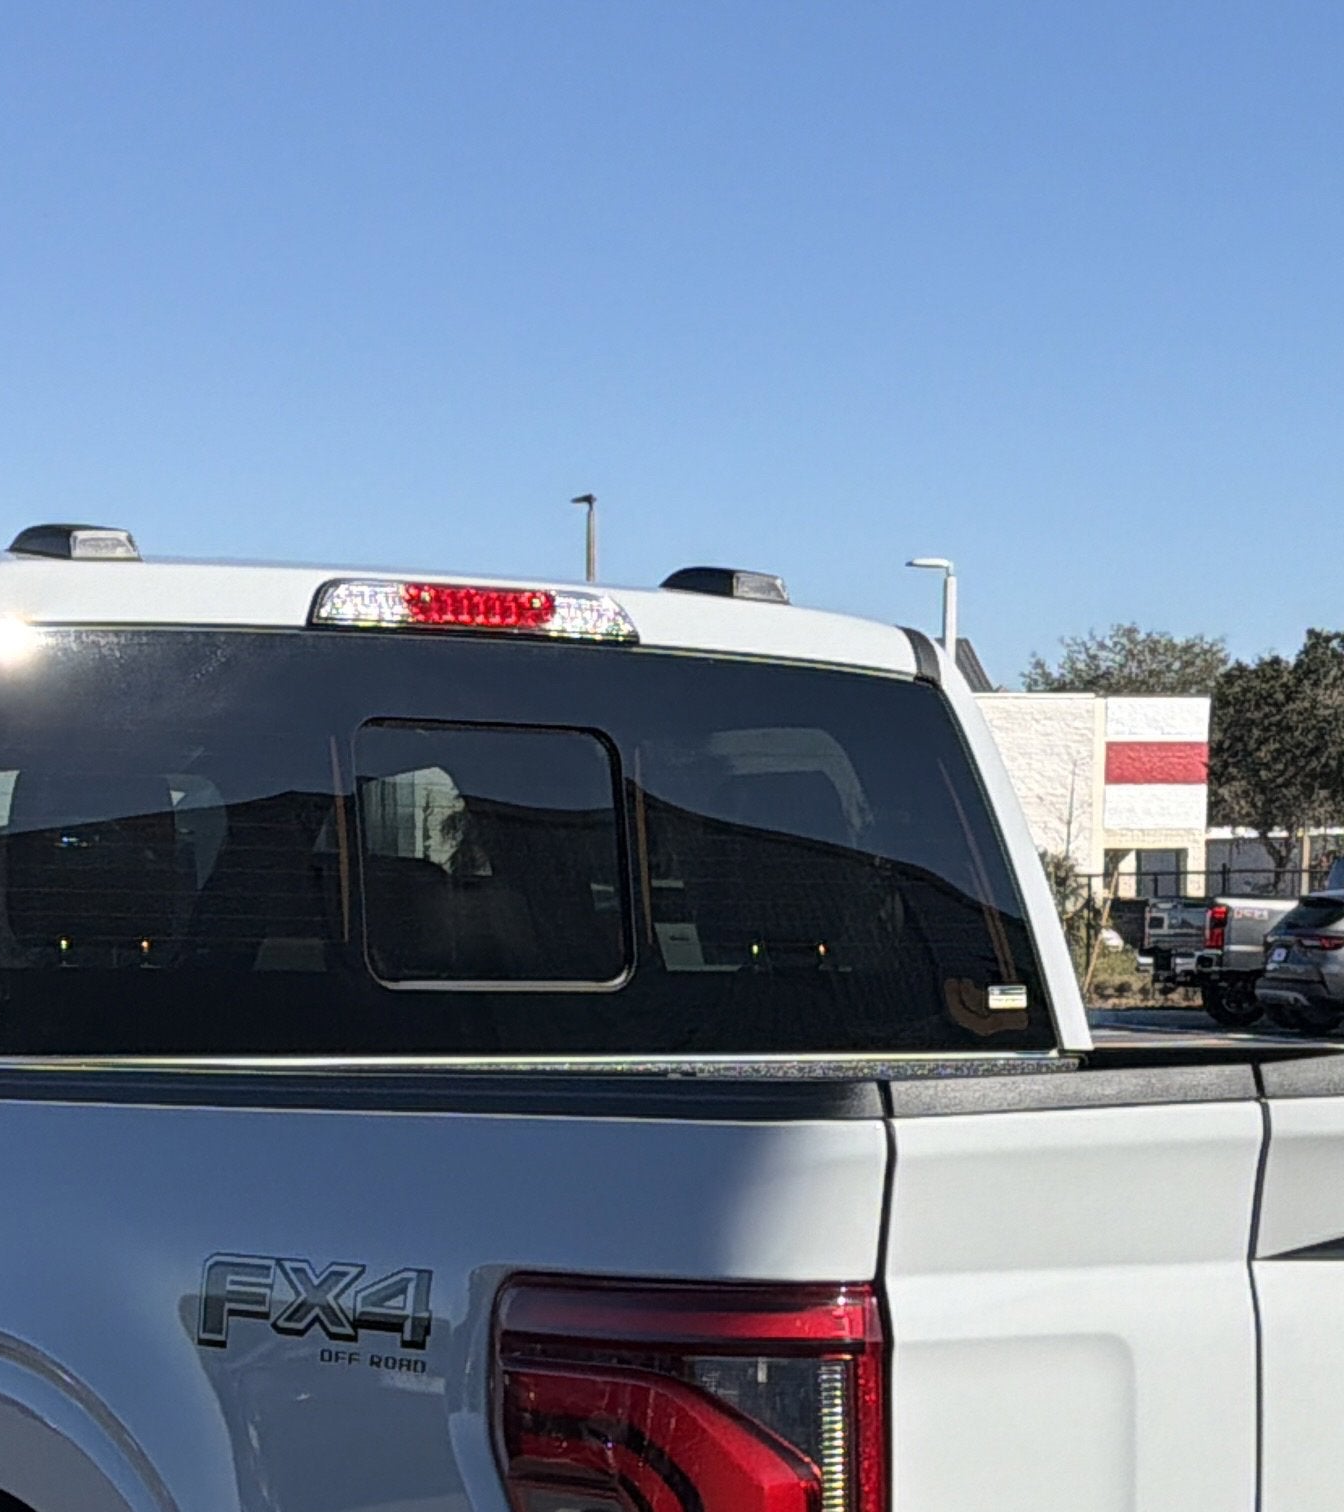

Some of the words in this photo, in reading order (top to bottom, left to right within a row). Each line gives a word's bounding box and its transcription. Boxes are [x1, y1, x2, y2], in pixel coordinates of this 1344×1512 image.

[197, 1251, 433, 1350] FX4
[319, 1348, 361, 1366] OFF
[369, 1354, 427, 1374] ROAD
